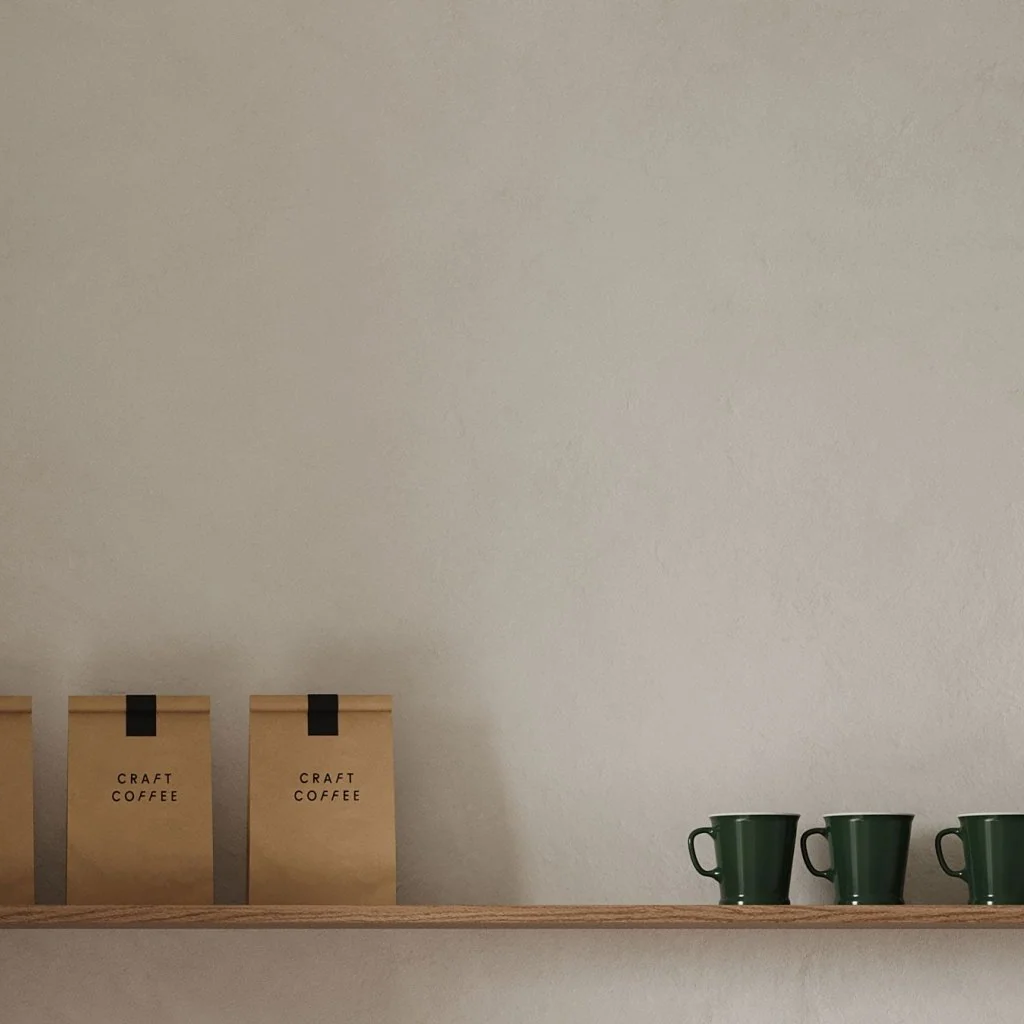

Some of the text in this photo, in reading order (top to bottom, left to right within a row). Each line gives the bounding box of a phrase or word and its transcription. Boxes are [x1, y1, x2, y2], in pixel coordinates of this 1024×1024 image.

[117, 772, 172, 785] CRAFT
[299, 772, 355, 784] CRAFT
[111, 790, 178, 803] COFFEE
[293, 789, 360, 802] COFFEE
